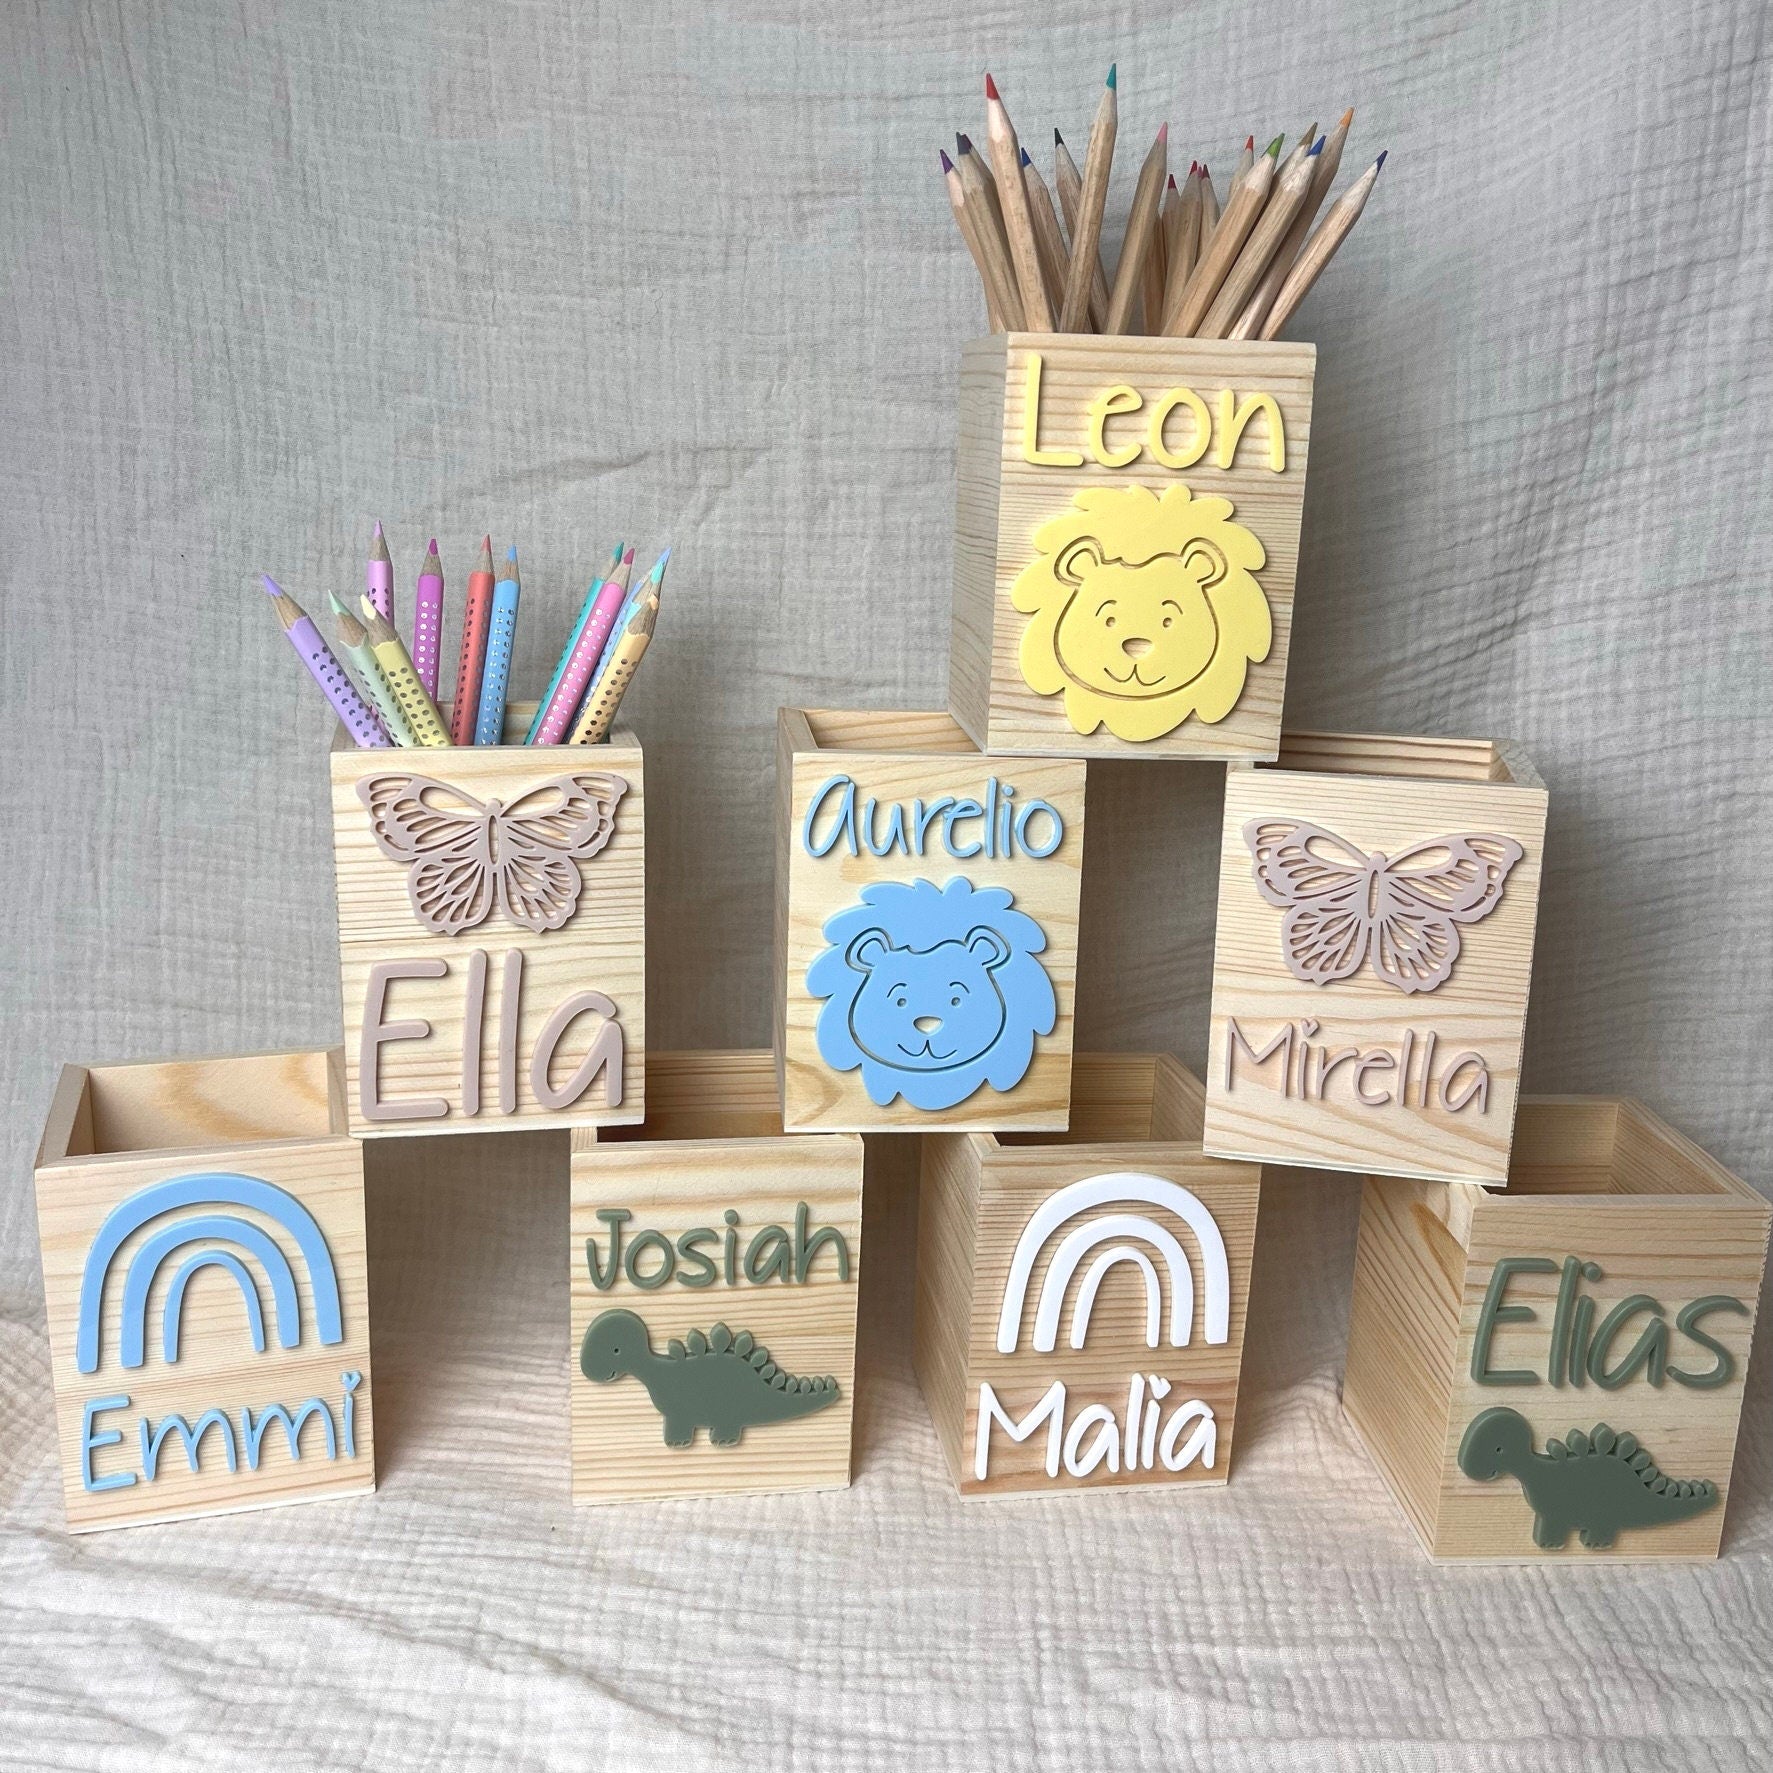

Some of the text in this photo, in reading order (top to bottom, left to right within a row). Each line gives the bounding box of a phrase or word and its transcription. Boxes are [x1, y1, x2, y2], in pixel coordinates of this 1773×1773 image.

[1023, 352, 1285, 473] Leon
[359, 947, 624, 1121] Ella
[1224, 1016, 1488, 1114] Mirella
[586, 1201, 849, 1290] Josiah
[1470, 1255, 1749, 1391] Elias
[82, 1370, 361, 1492] Emmi
[975, 1372, 1217, 1481] Malia
